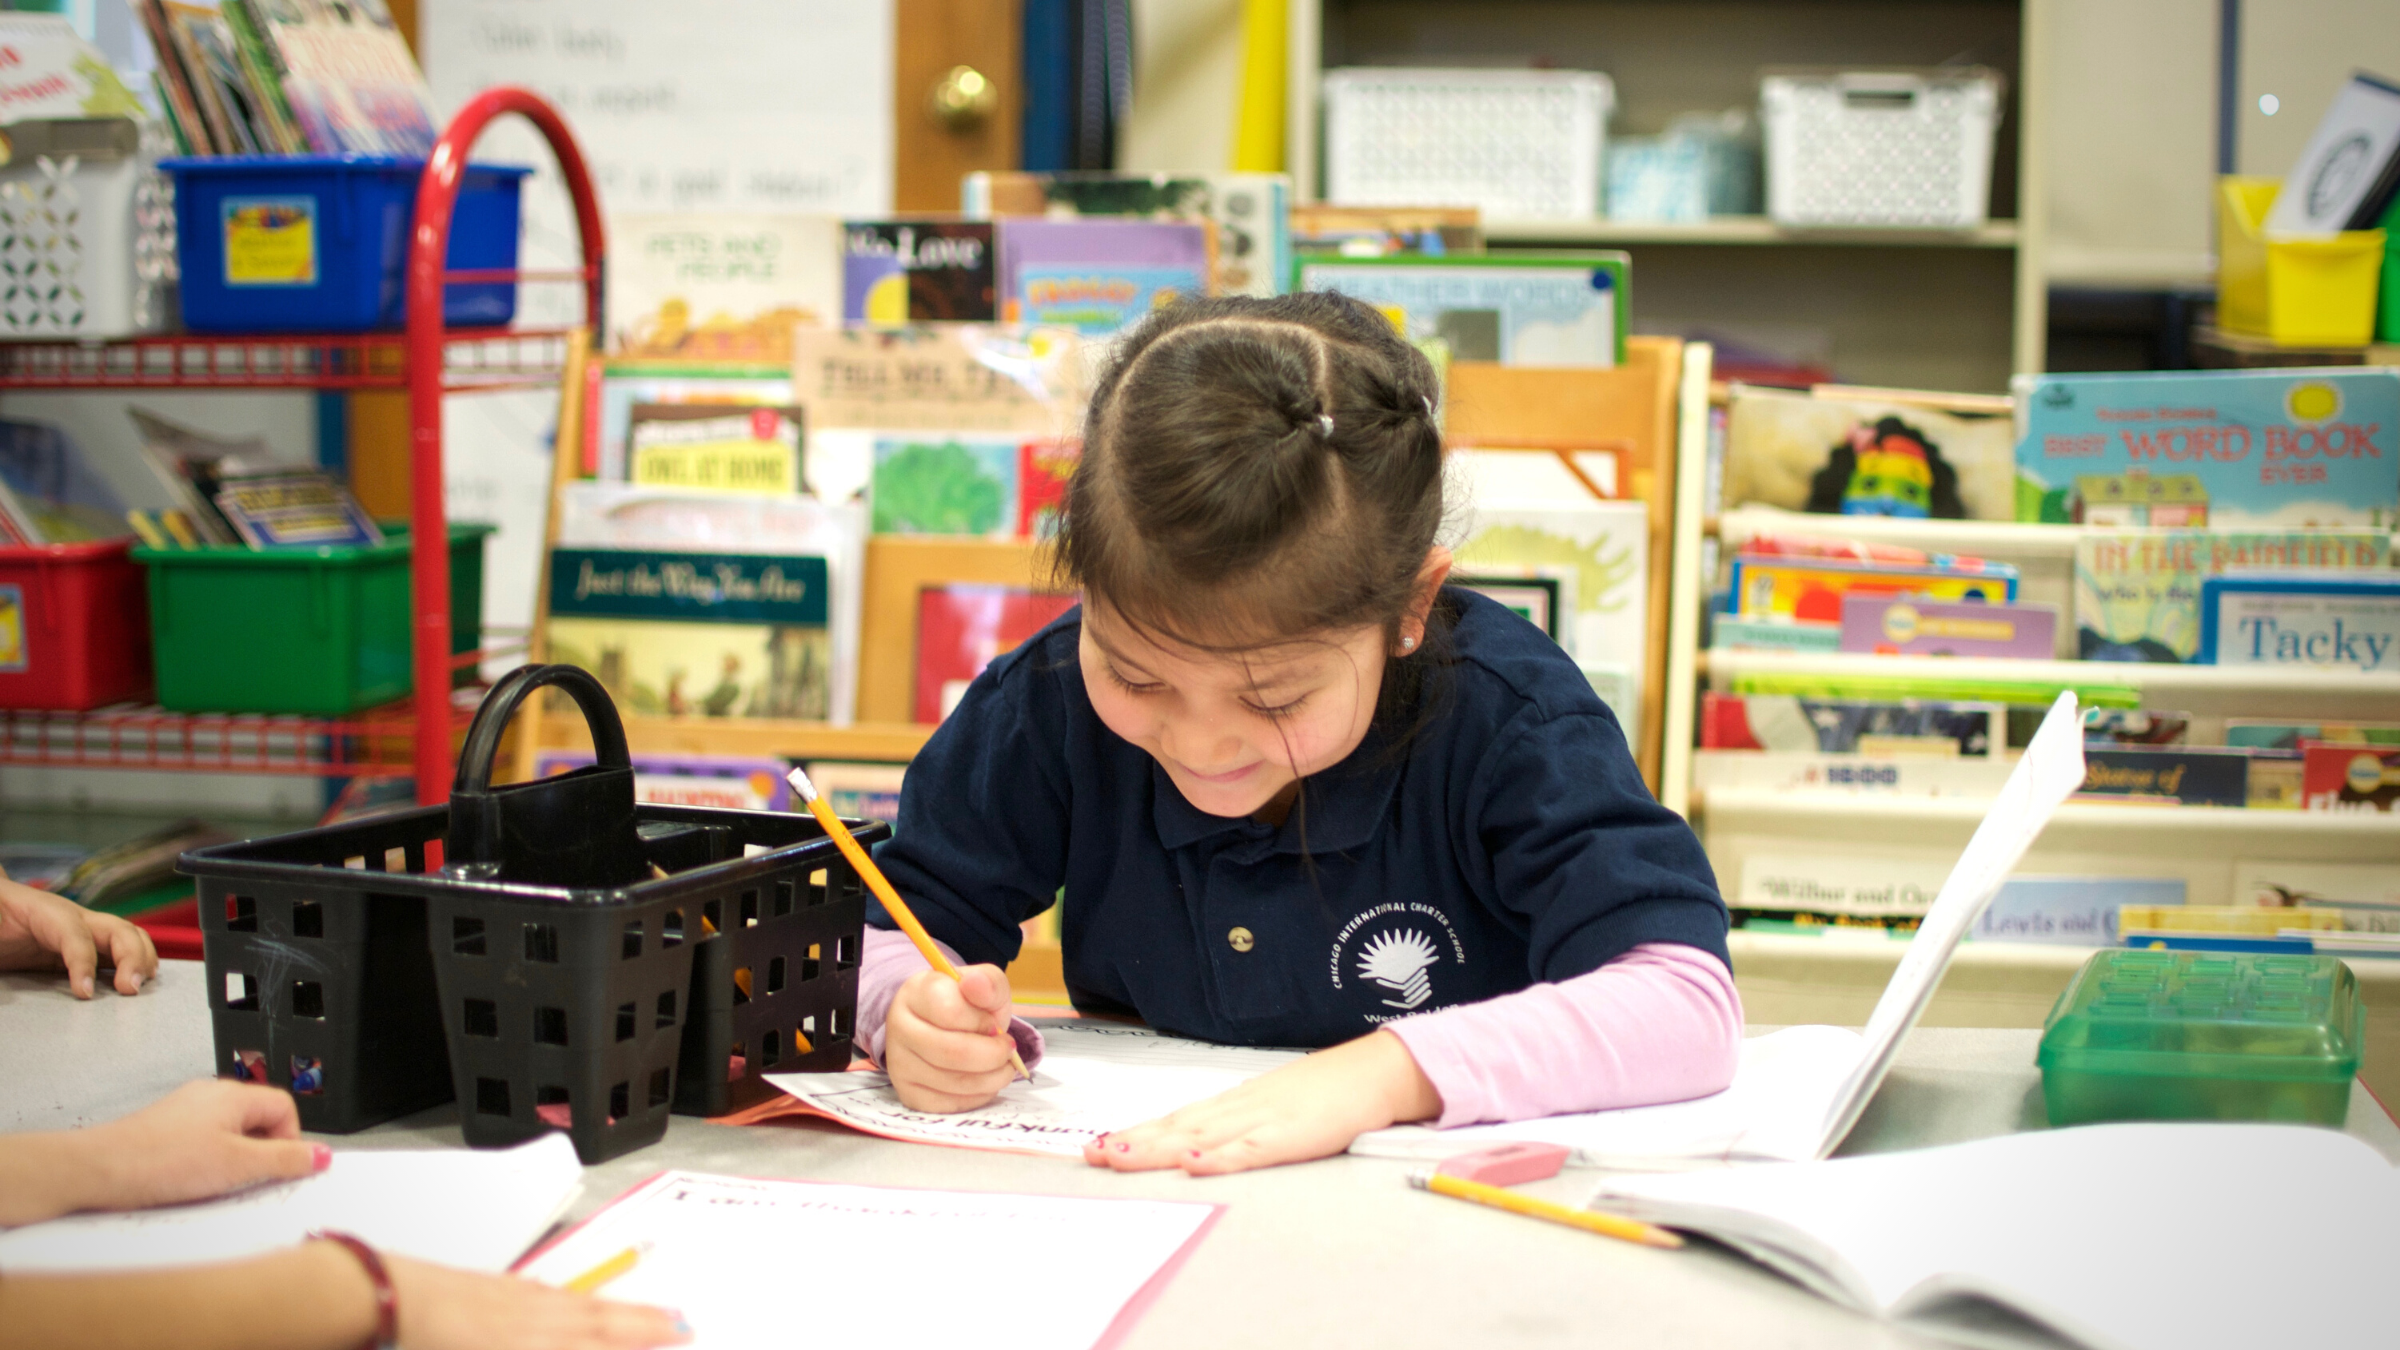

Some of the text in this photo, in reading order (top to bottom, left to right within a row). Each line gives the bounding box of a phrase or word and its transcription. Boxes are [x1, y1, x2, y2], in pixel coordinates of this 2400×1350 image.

[2120, 425, 2250, 461] WORD
[2265, 422, 2382, 461] BOOK
[2260, 462, 2328, 484] EVER
[2238, 616, 2393, 673] Tacky
[1329, 902, 1465, 989] CHICAGO INTERNATIONAL CHARTER SCHOOL
[1363, 1013, 1402, 1024] West
[955, 1118, 1112, 1140] hankful
